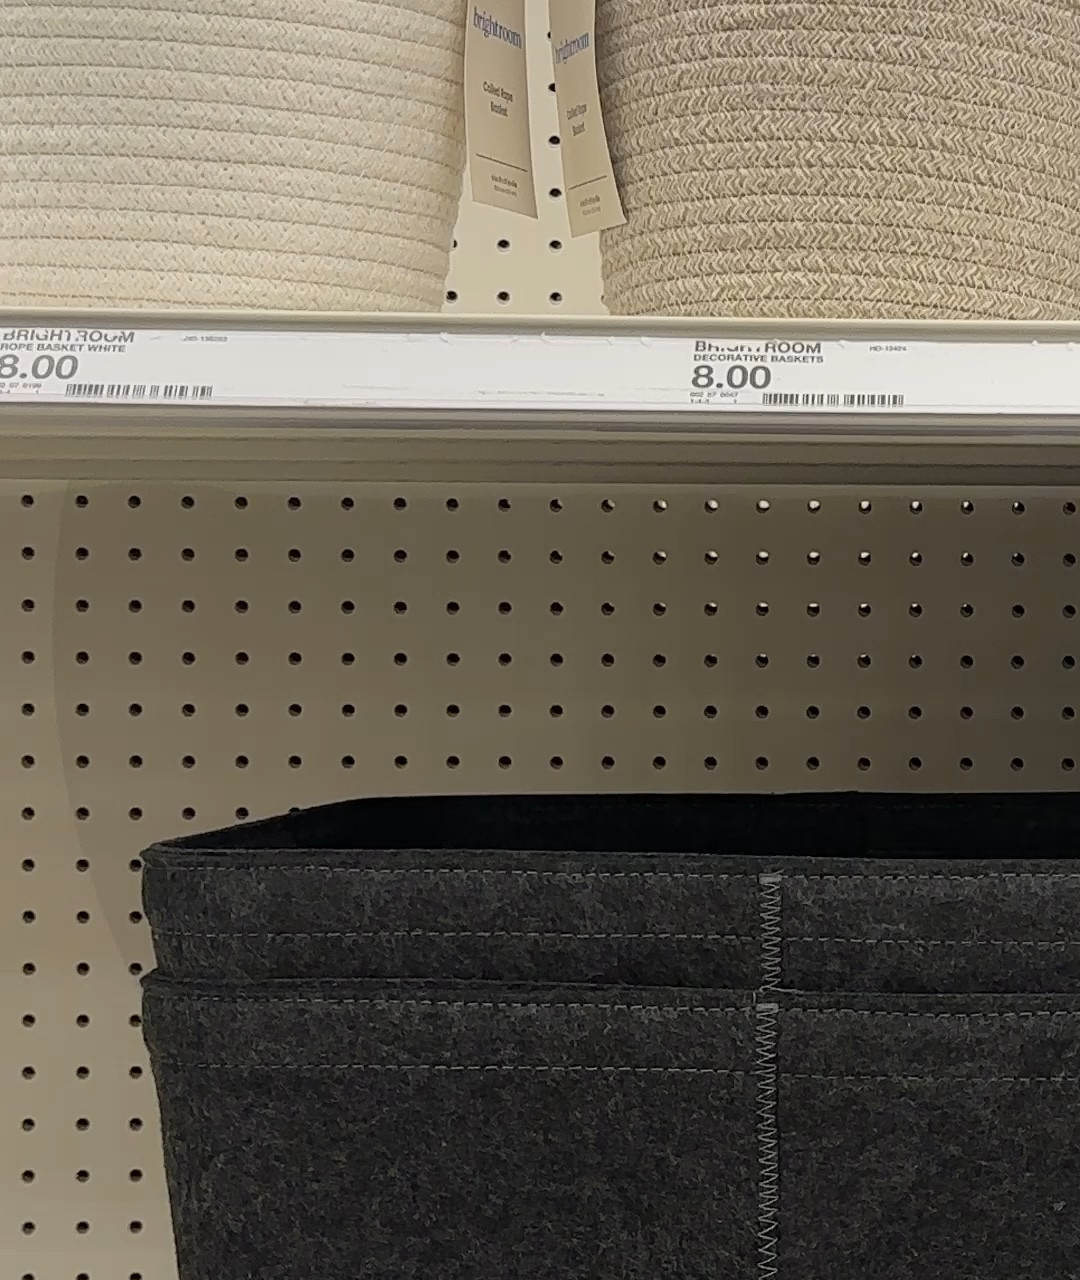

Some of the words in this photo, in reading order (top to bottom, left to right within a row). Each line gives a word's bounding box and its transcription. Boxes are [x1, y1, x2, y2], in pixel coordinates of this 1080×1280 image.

[473, 6, 522, 50] brightroom
[0, 343, 34, 352] ROPE
[36, 343, 85, 352] BASKET
[88, 344, 127, 353] WHITE
[693, 354, 768, 363] DECORATIVE
[771, 355, 824, 364] BASKETS
[0, 354, 79, 380] 8.00
[691, 364, 772, 389] 8.00
